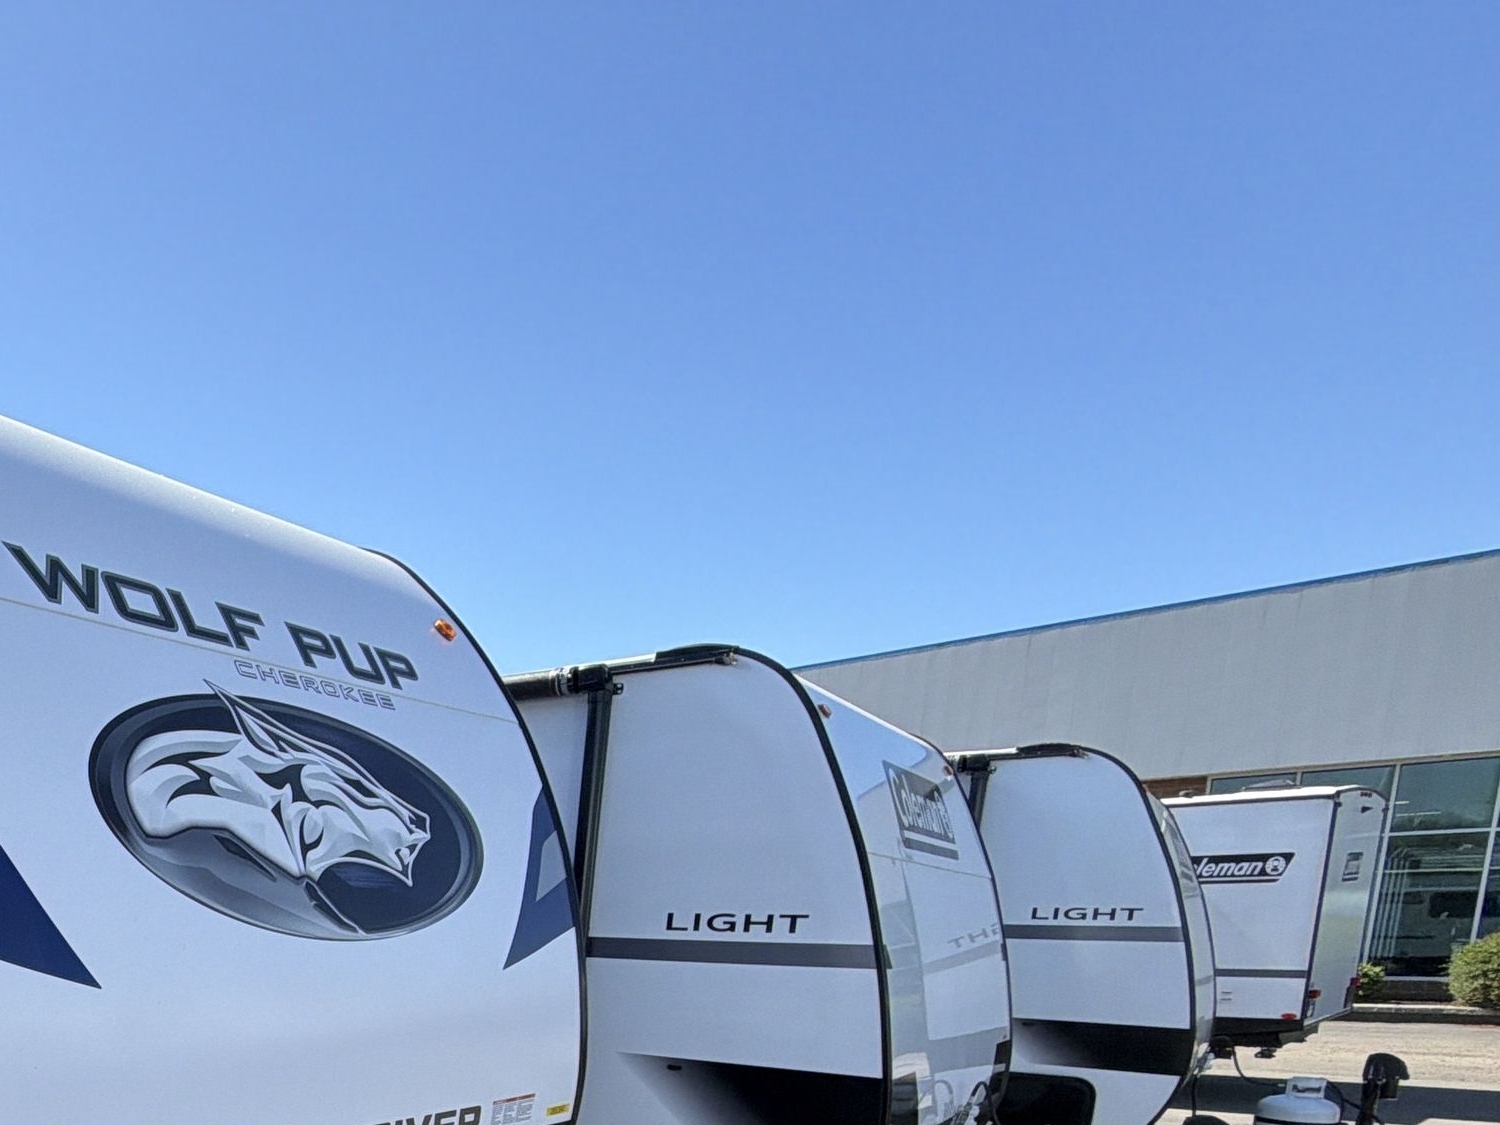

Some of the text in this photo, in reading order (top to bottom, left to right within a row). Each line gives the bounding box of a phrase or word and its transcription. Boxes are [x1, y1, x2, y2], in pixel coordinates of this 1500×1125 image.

[2, 540, 419, 691] WOLF PUP
[232, 659, 397, 711] CHEROKEE
[1193, 857, 1264, 877] leman
[665, 912, 810, 934] LIGHT
[1030, 906, 1145, 921] LIGHT
